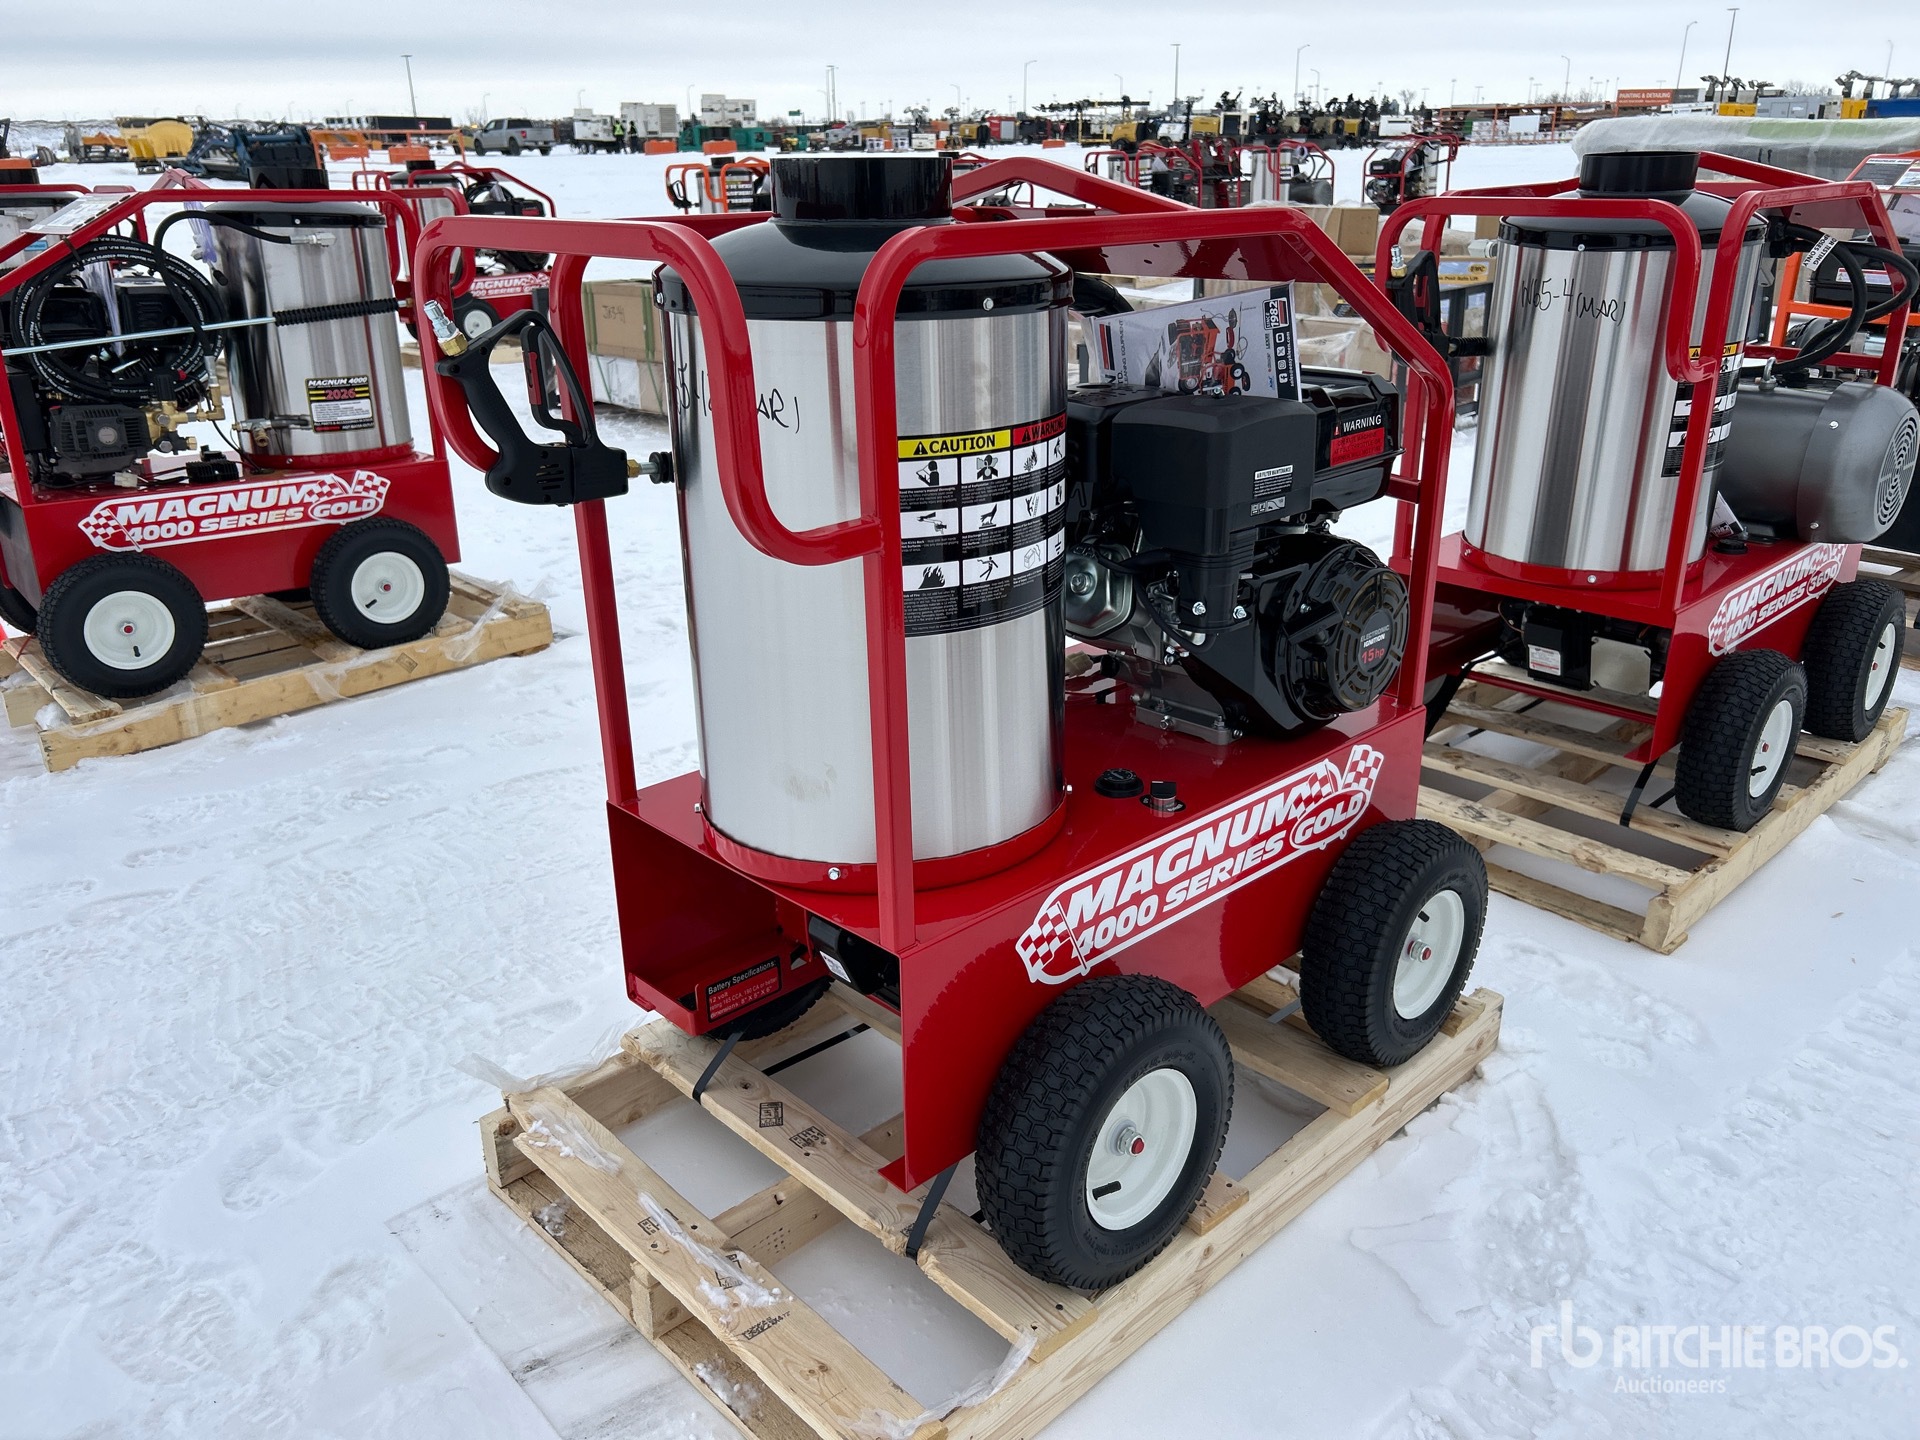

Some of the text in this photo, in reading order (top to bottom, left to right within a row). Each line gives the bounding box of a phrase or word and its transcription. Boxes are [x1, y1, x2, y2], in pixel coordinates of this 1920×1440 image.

[1803, 250, 1816, 267] ONLY
[1813, 243, 1832, 266] TESTING
[1269, 301, 1279, 328] 1982
[308, 378, 347, 387] MAGNUM
[348, 376, 368, 384] 4000
[325, 388, 356, 400] 2026
[1030, 417, 1064, 440] WARNING
[1343, 414, 1382, 433] WARNING
[929, 434, 996, 454] CAUTION
[115, 484, 312, 525] MAGNUM
[125, 498, 376, 542] 4000 SERIES GOLD
[1726, 554, 1820, 623] MAGNUM
[1724, 563, 1838, 643] 4000 SERIES 3600
[1360, 625, 1390, 642] ELECTRONIC
[1363, 633, 1386, 648] IGNITION
[1067, 782, 1307, 929] MAGNUM
[1071, 794, 1360, 959] 4000 SERIES GOLD
[708, 960, 776, 995] Battery Specifications:
